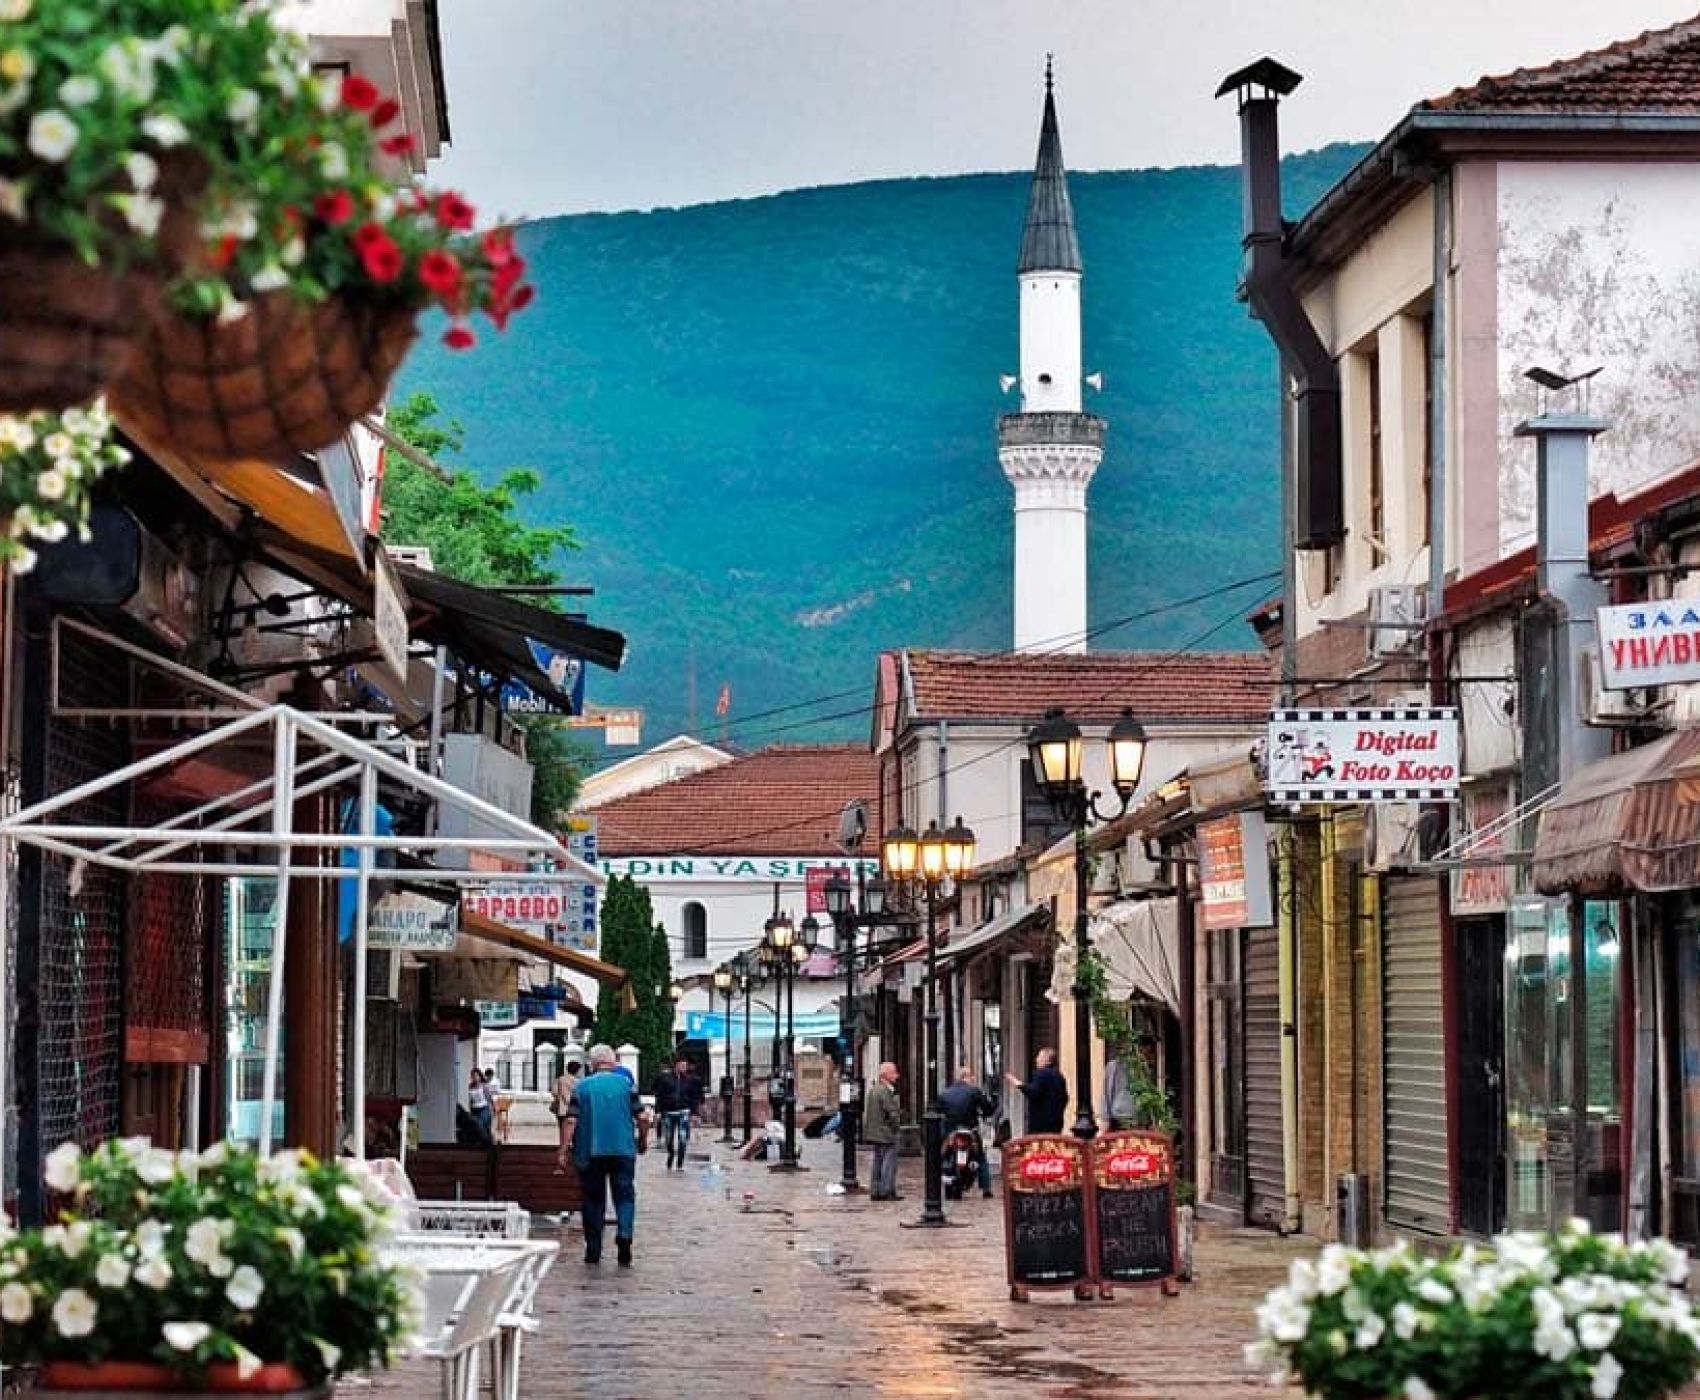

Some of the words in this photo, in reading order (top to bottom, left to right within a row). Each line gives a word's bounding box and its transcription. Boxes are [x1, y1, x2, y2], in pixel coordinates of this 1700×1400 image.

[1354, 729, 1438, 756] Digital
[1340, 760, 1392, 781] Foto
[1395, 760, 1454, 783] Koço
